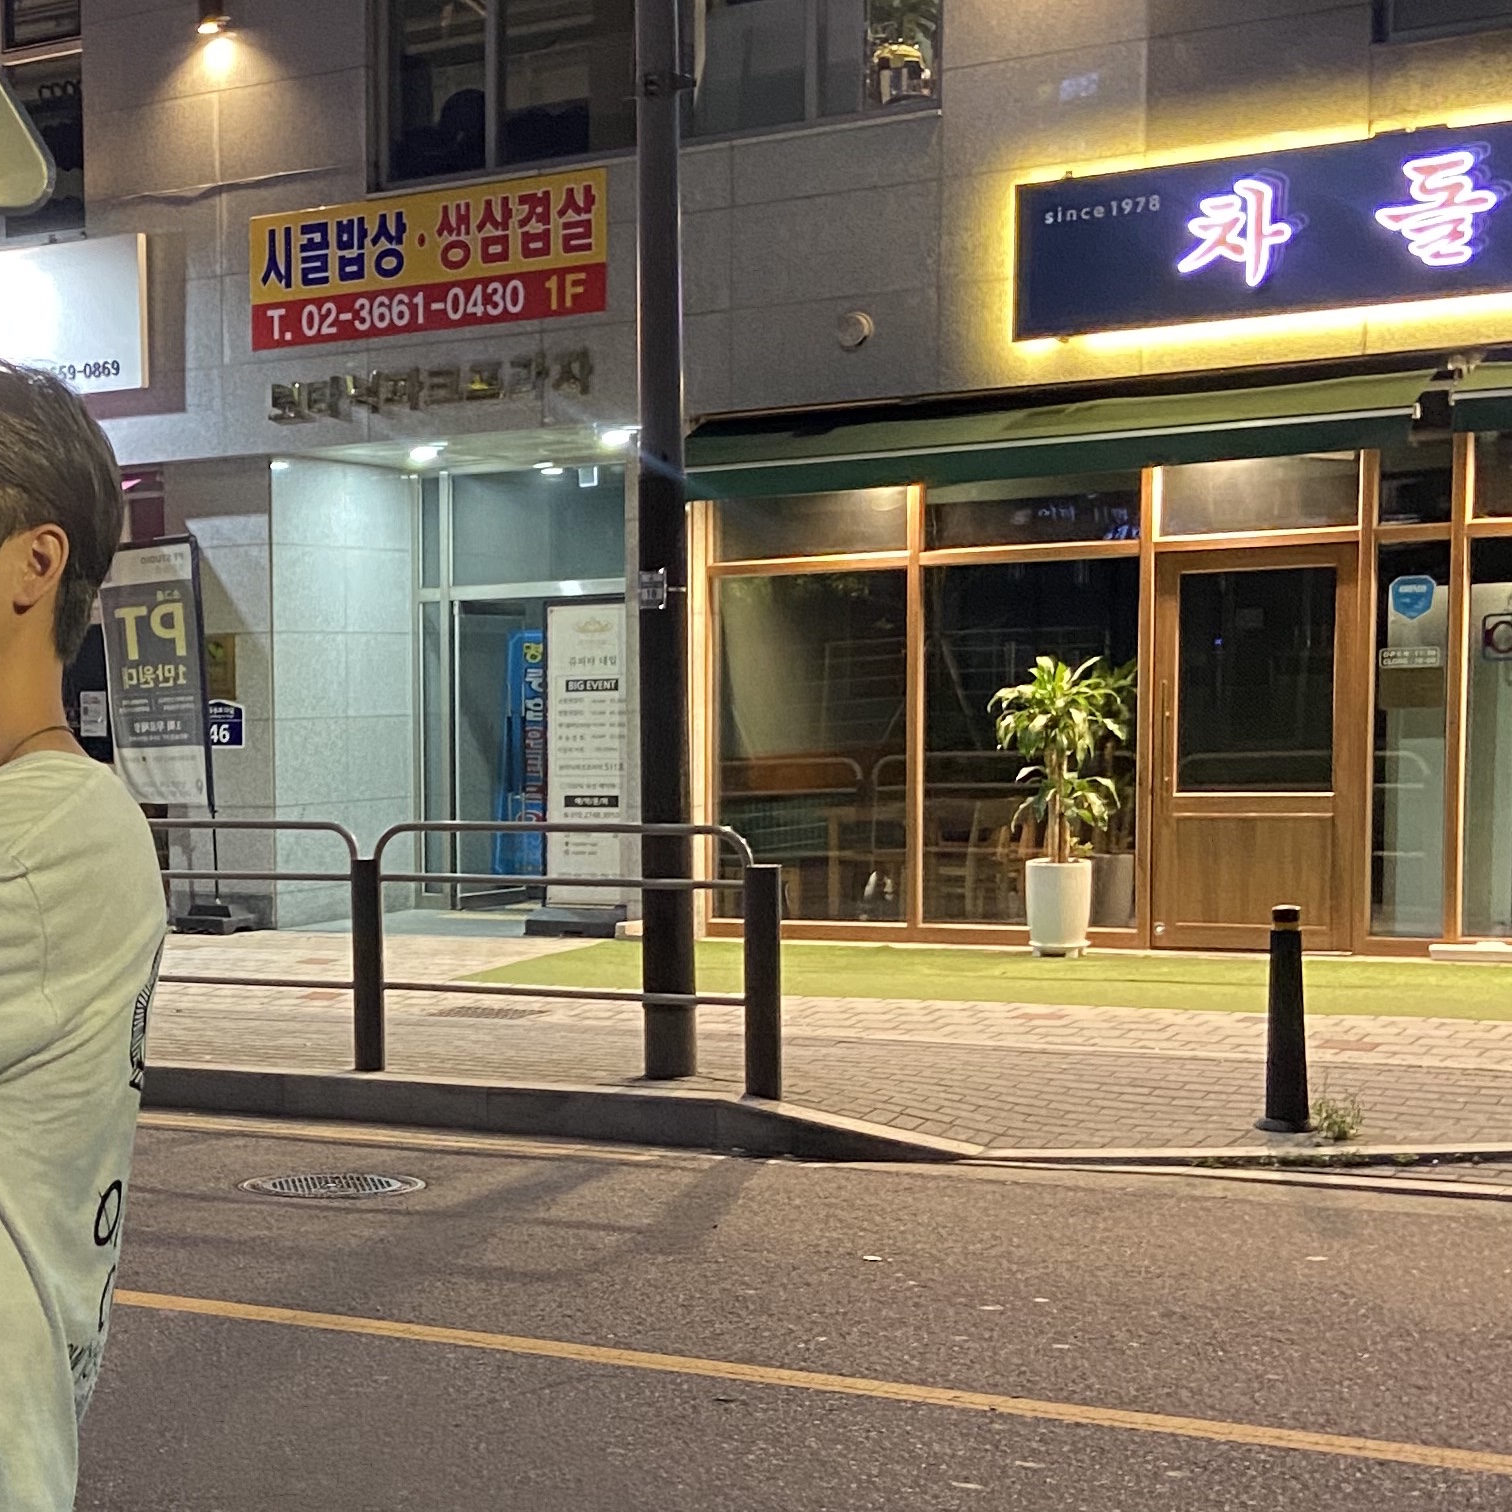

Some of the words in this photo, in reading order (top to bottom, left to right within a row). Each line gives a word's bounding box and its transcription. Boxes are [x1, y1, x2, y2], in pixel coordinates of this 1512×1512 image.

[261, 211, 407, 289] 시골밥상
[436, 183, 596, 271] 생삼겹살
[301, 279, 525, 336] 02-3661-0430
[544, 272, 587, 311] 1F
[568, 680, 585, 691] BIG
[586, 679, 617, 691] EVENT
[210, 724, 230, 743] 46
